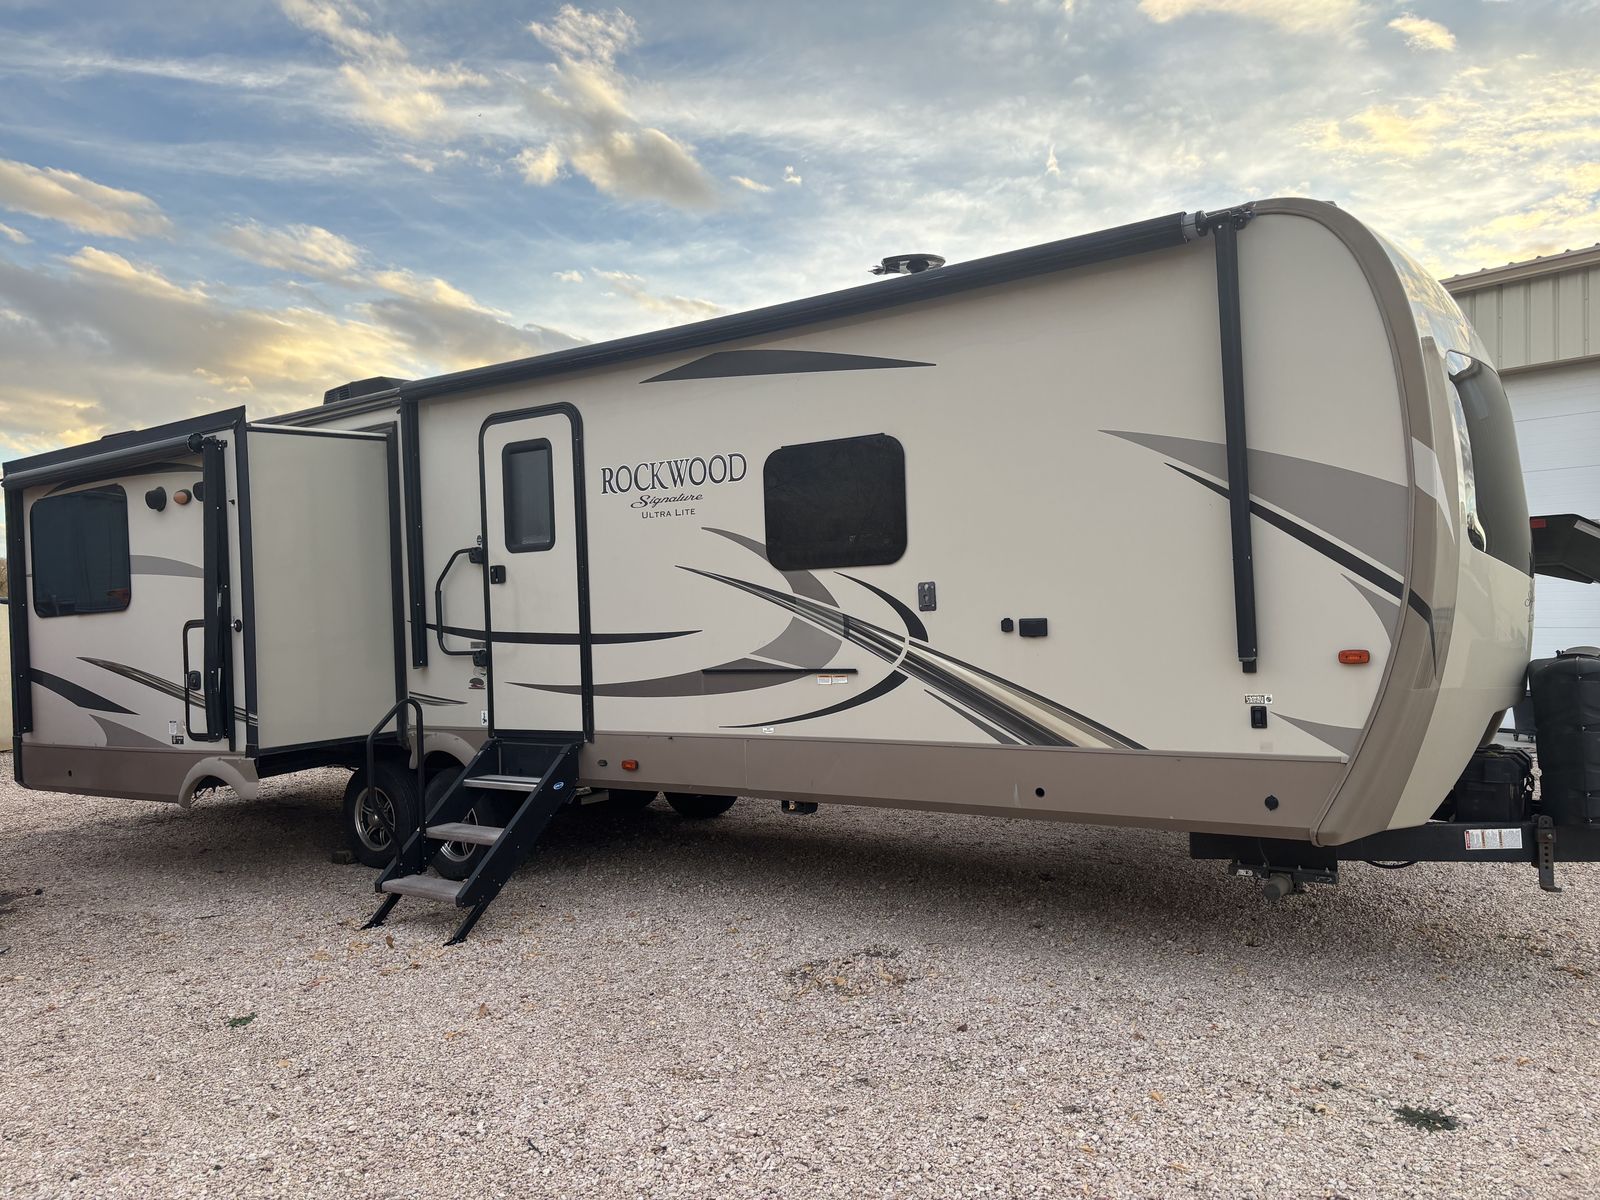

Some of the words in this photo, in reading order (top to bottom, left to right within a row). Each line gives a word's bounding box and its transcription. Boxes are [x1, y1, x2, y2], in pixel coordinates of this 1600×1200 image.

[600, 453, 747, 495] ROCKWOOD
[630, 492, 704, 509] Signature
[641, 510, 672, 519] ULTRA
[674, 508, 696, 517] LITE
